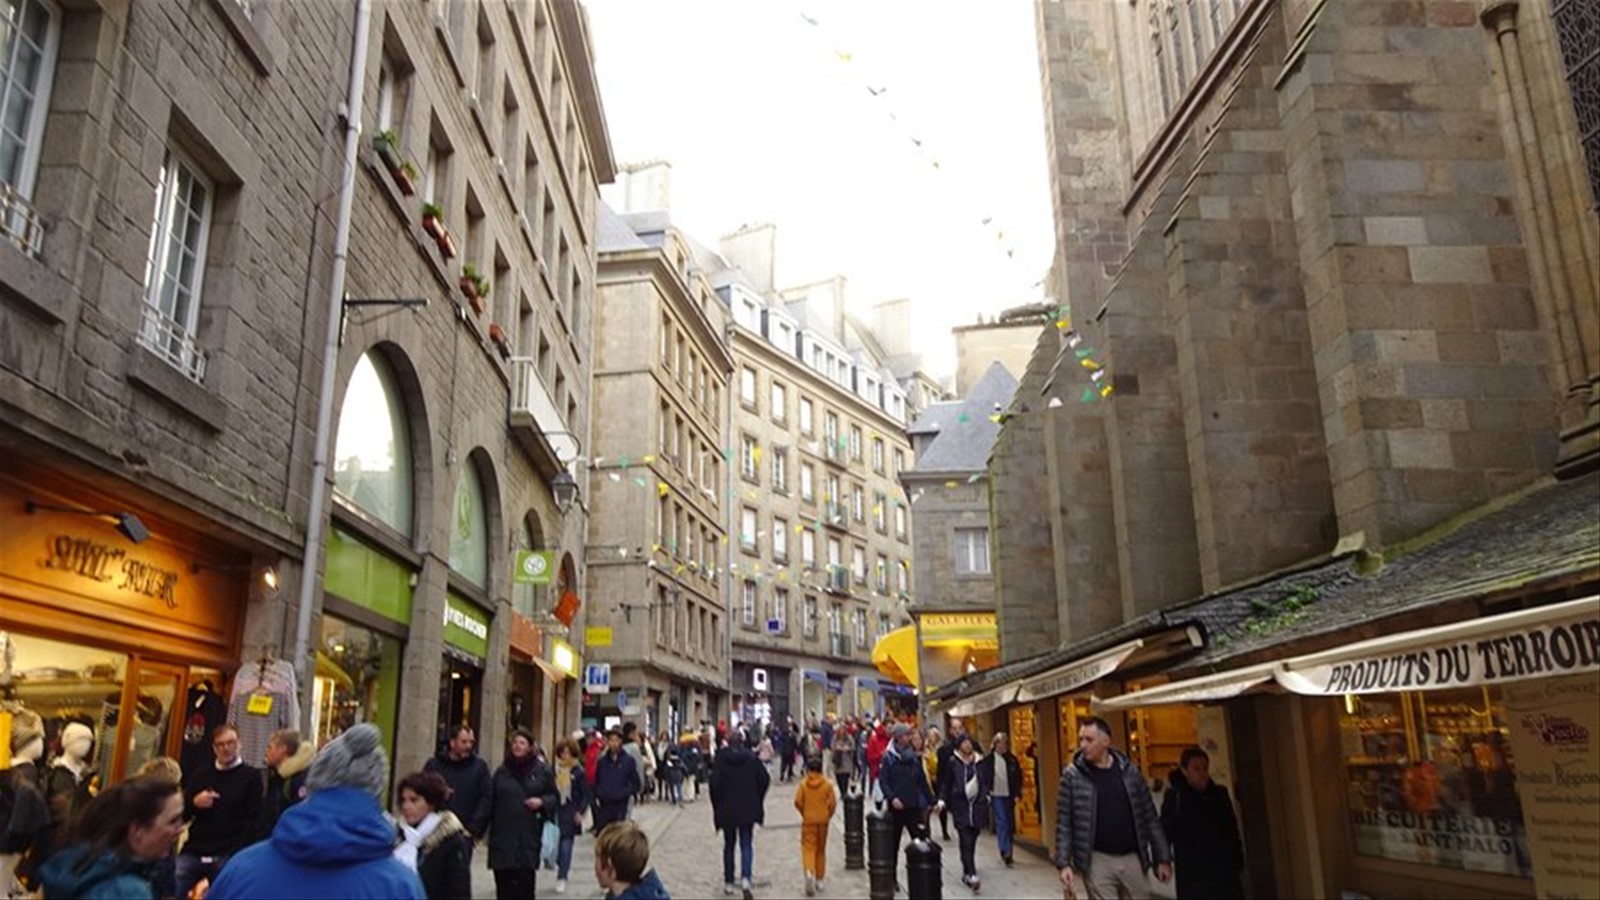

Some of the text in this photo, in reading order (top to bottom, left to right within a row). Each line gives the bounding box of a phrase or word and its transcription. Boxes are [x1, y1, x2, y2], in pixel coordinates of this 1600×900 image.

[1325, 652, 1430, 692] PRODUITS
[1435, 645, 1471, 684] DU
[1456, 833, 1512, 855] MALO
